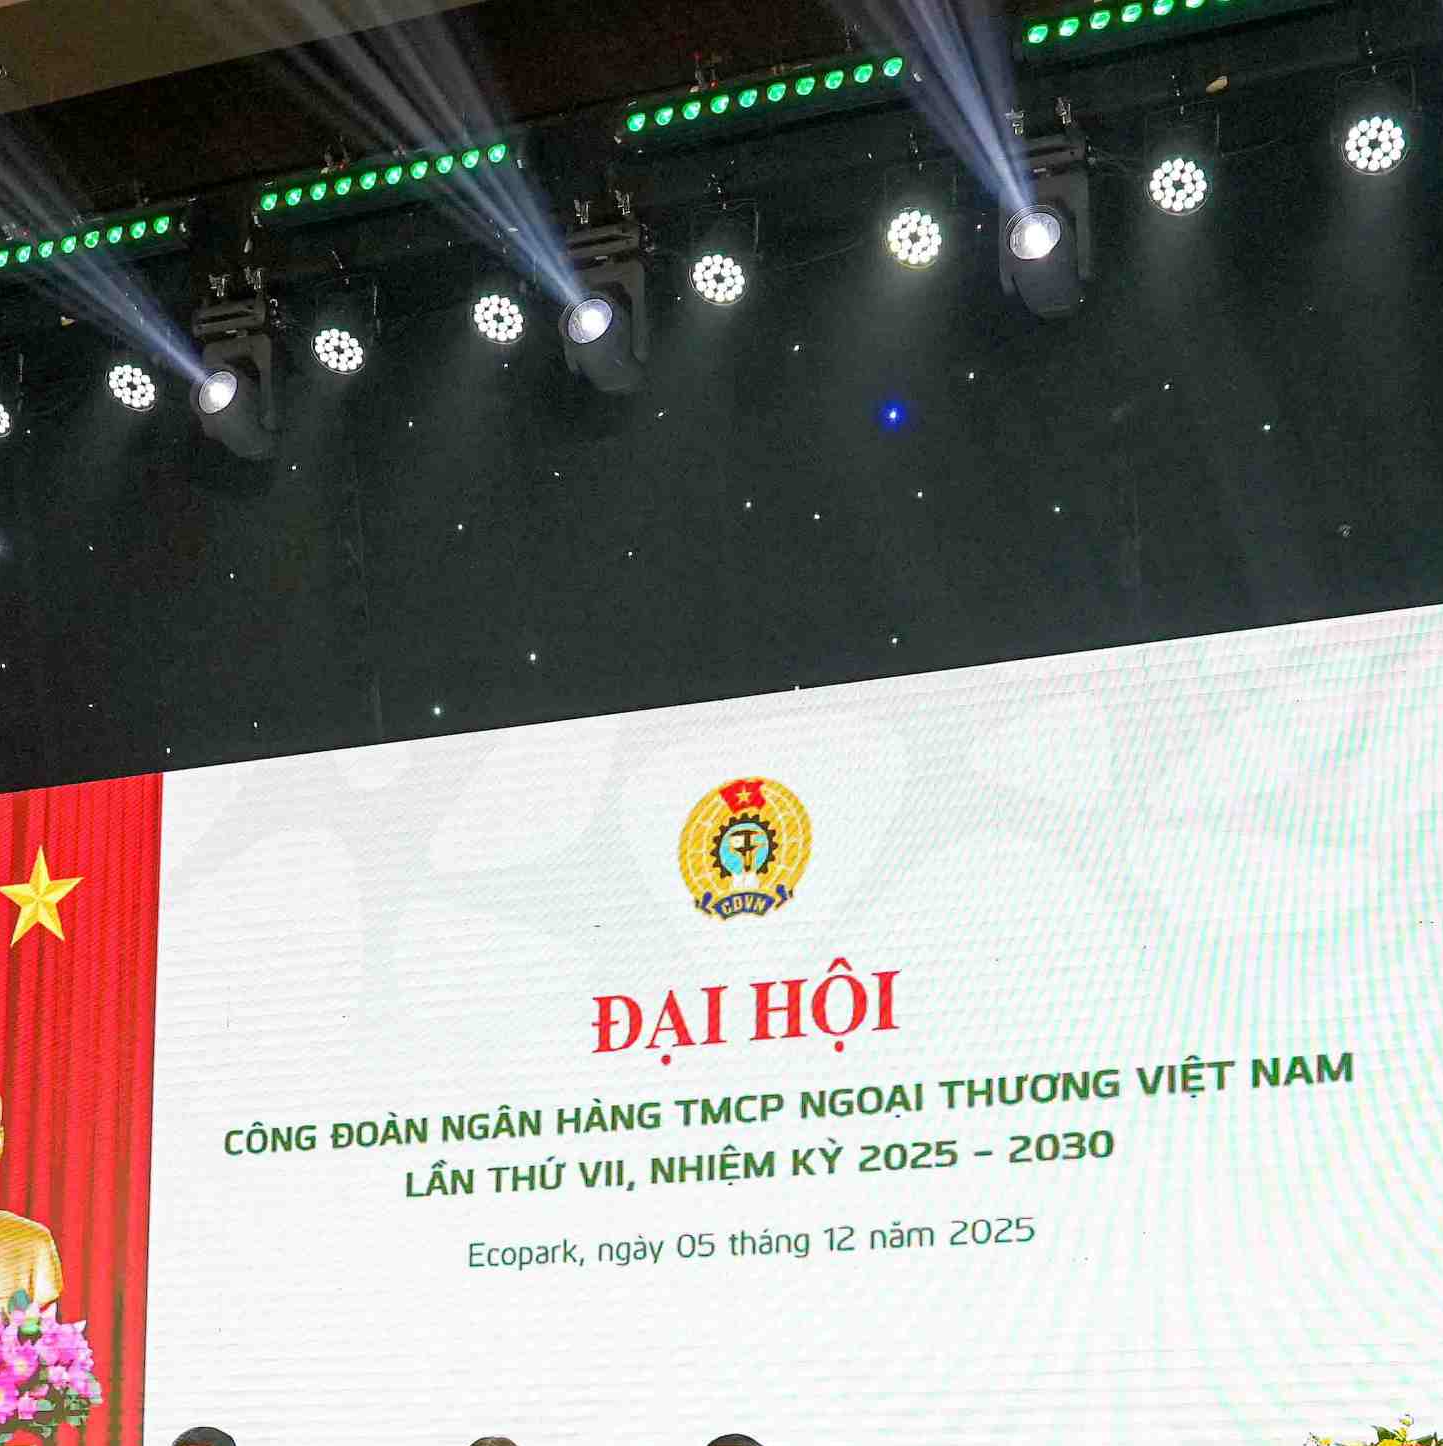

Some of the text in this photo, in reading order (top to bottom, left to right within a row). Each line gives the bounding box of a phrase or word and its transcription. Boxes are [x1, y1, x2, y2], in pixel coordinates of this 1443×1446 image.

[591, 956, 900, 1066] ĐẠI HỘI
[224, 1051, 1353, 1157] CÔNG ĐOÀN NGÂN HÀNG TMCP NGOẠI THƯƠNG VIỆT NAM
[405, 1159, 475, 1198] LẦN
[487, 1155, 567, 1194] THỨ
[578, 1159, 636, 1192] VII,
[650, 1143, 776, 1185] NHIỆM
[791, 1137, 844, 1177] KỲ
[858, 1139, 959, 1173] 2025
[1008, 1129, 1115, 1164] 2030
[468, 1216, 1036, 1272] Ecopark, ngày 05 tháng 12 năm 2025
